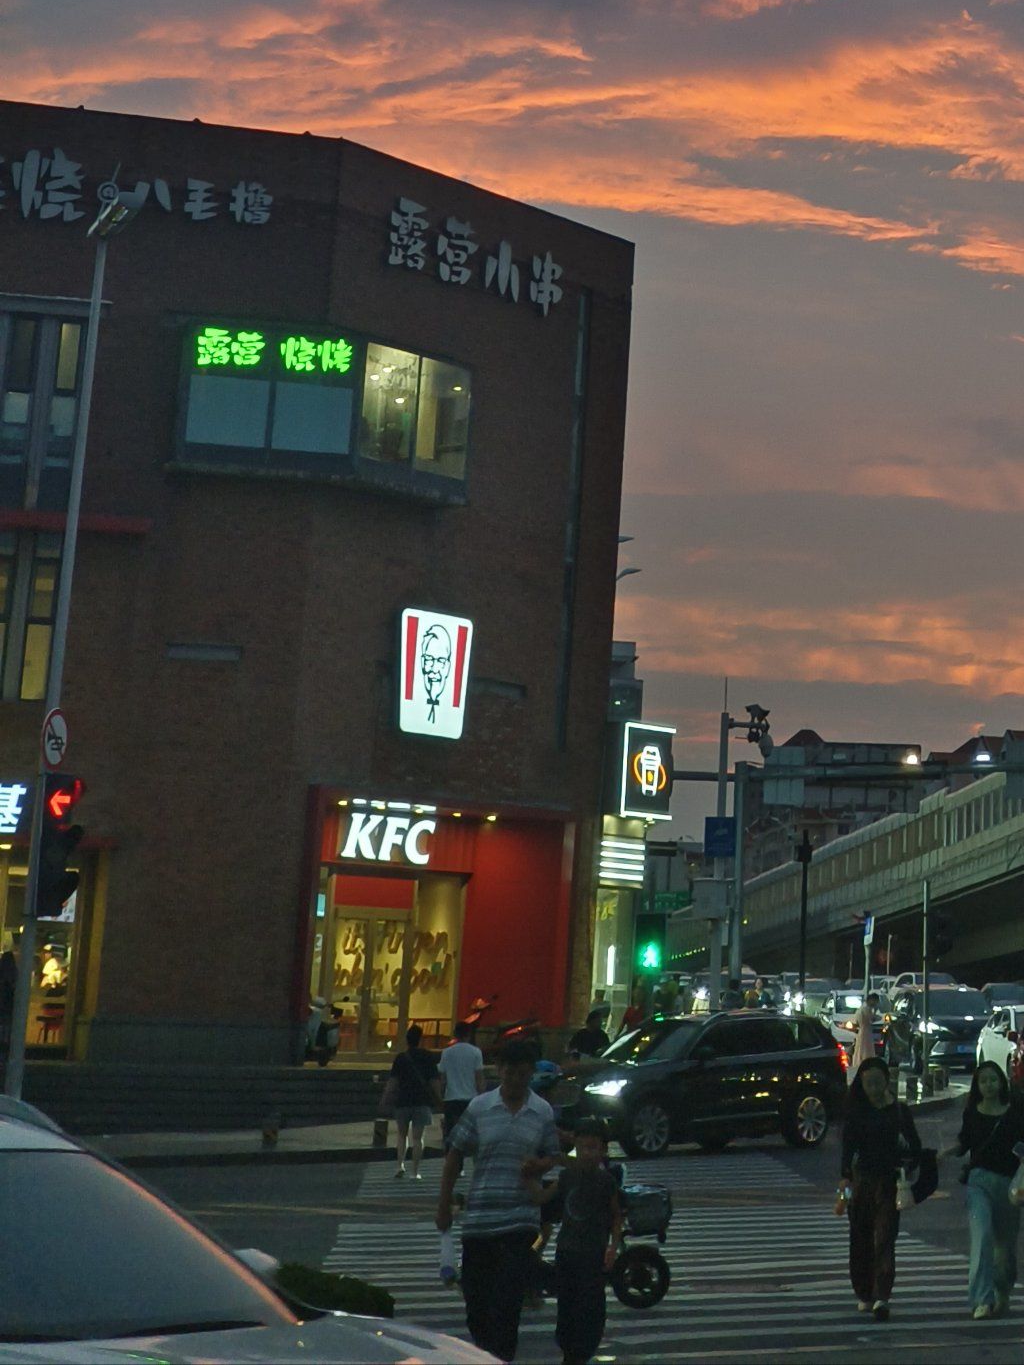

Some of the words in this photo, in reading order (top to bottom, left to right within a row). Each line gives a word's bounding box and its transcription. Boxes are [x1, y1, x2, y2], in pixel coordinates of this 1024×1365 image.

[388, 196, 564, 318] 露营小串
[197, 327, 266, 366] 露营
[280, 336, 353, 373] 烧烤
[340, 812, 437, 865] KFC
